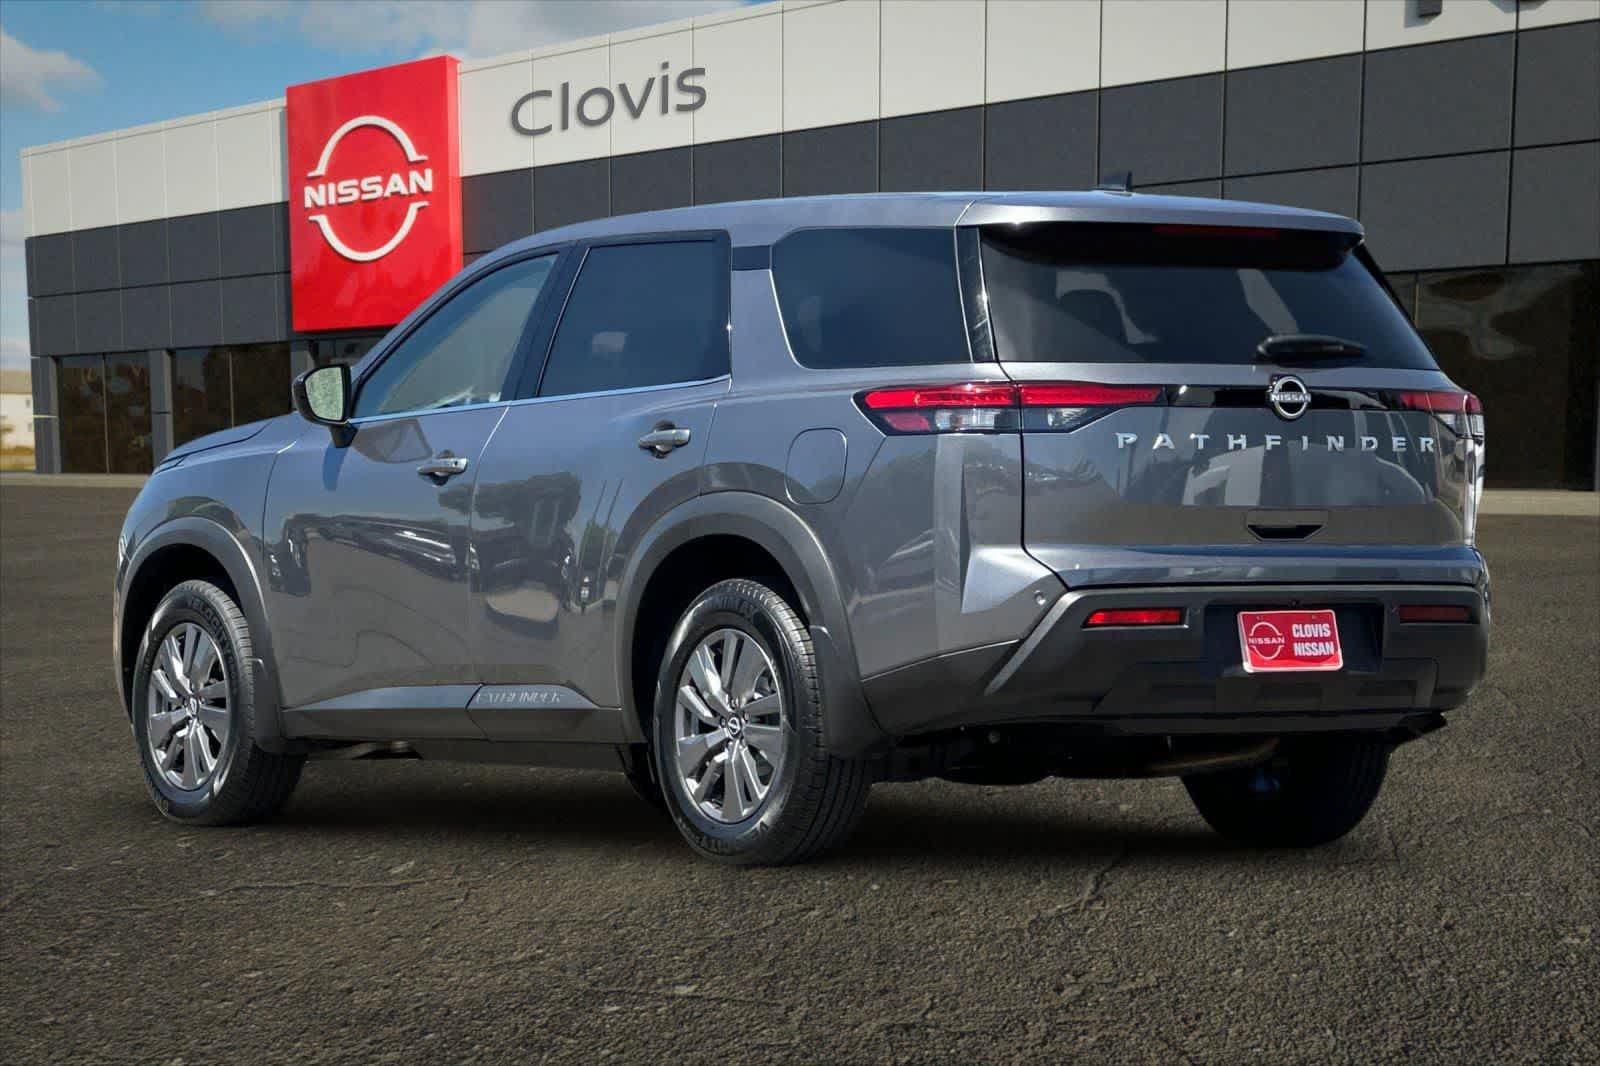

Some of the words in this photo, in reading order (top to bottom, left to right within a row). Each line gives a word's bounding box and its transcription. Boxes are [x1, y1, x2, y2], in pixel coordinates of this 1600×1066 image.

[511, 62, 706, 136] Clovis
[304, 169, 433, 208] NISSAN
[1271, 392, 1311, 402] NISSAN
[1116, 432, 1434, 452] PATHFINDER
[1293, 624, 1329, 638] CLOVIS
[1248, 637, 1285, 645] NISSAN
[1293, 641, 1334, 656] NISSAN
